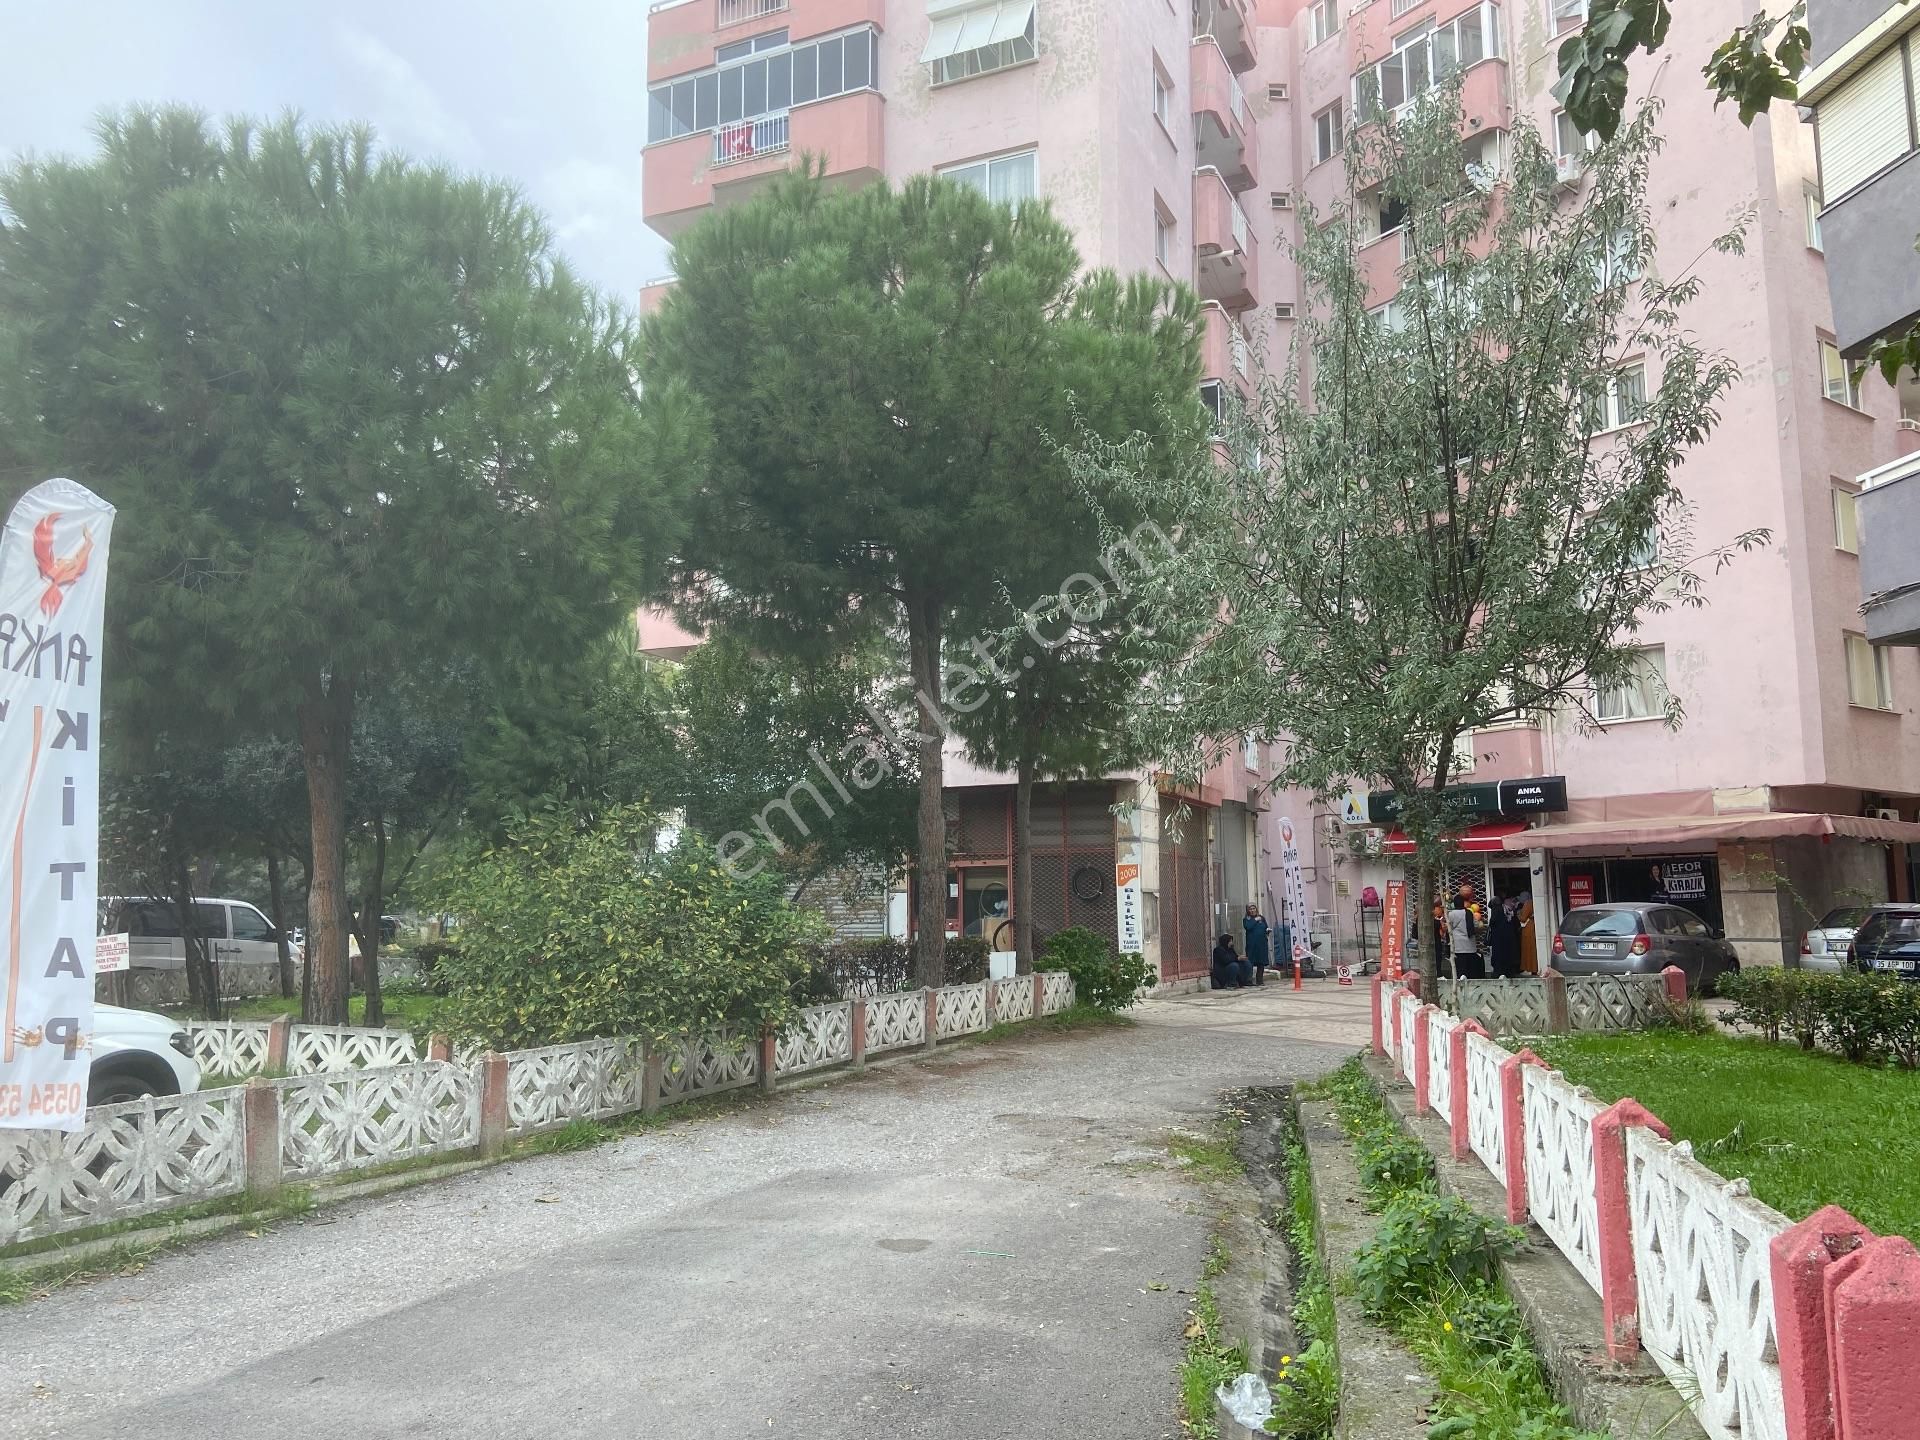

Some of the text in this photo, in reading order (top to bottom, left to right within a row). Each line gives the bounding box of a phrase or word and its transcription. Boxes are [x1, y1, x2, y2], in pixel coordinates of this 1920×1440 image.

[1517, 787, 1542, 795] ANKA
[1671, 861, 1702, 872] EFOR
[1120, 867, 1137, 880] 2006
[1571, 880, 1589, 890] ANKA
